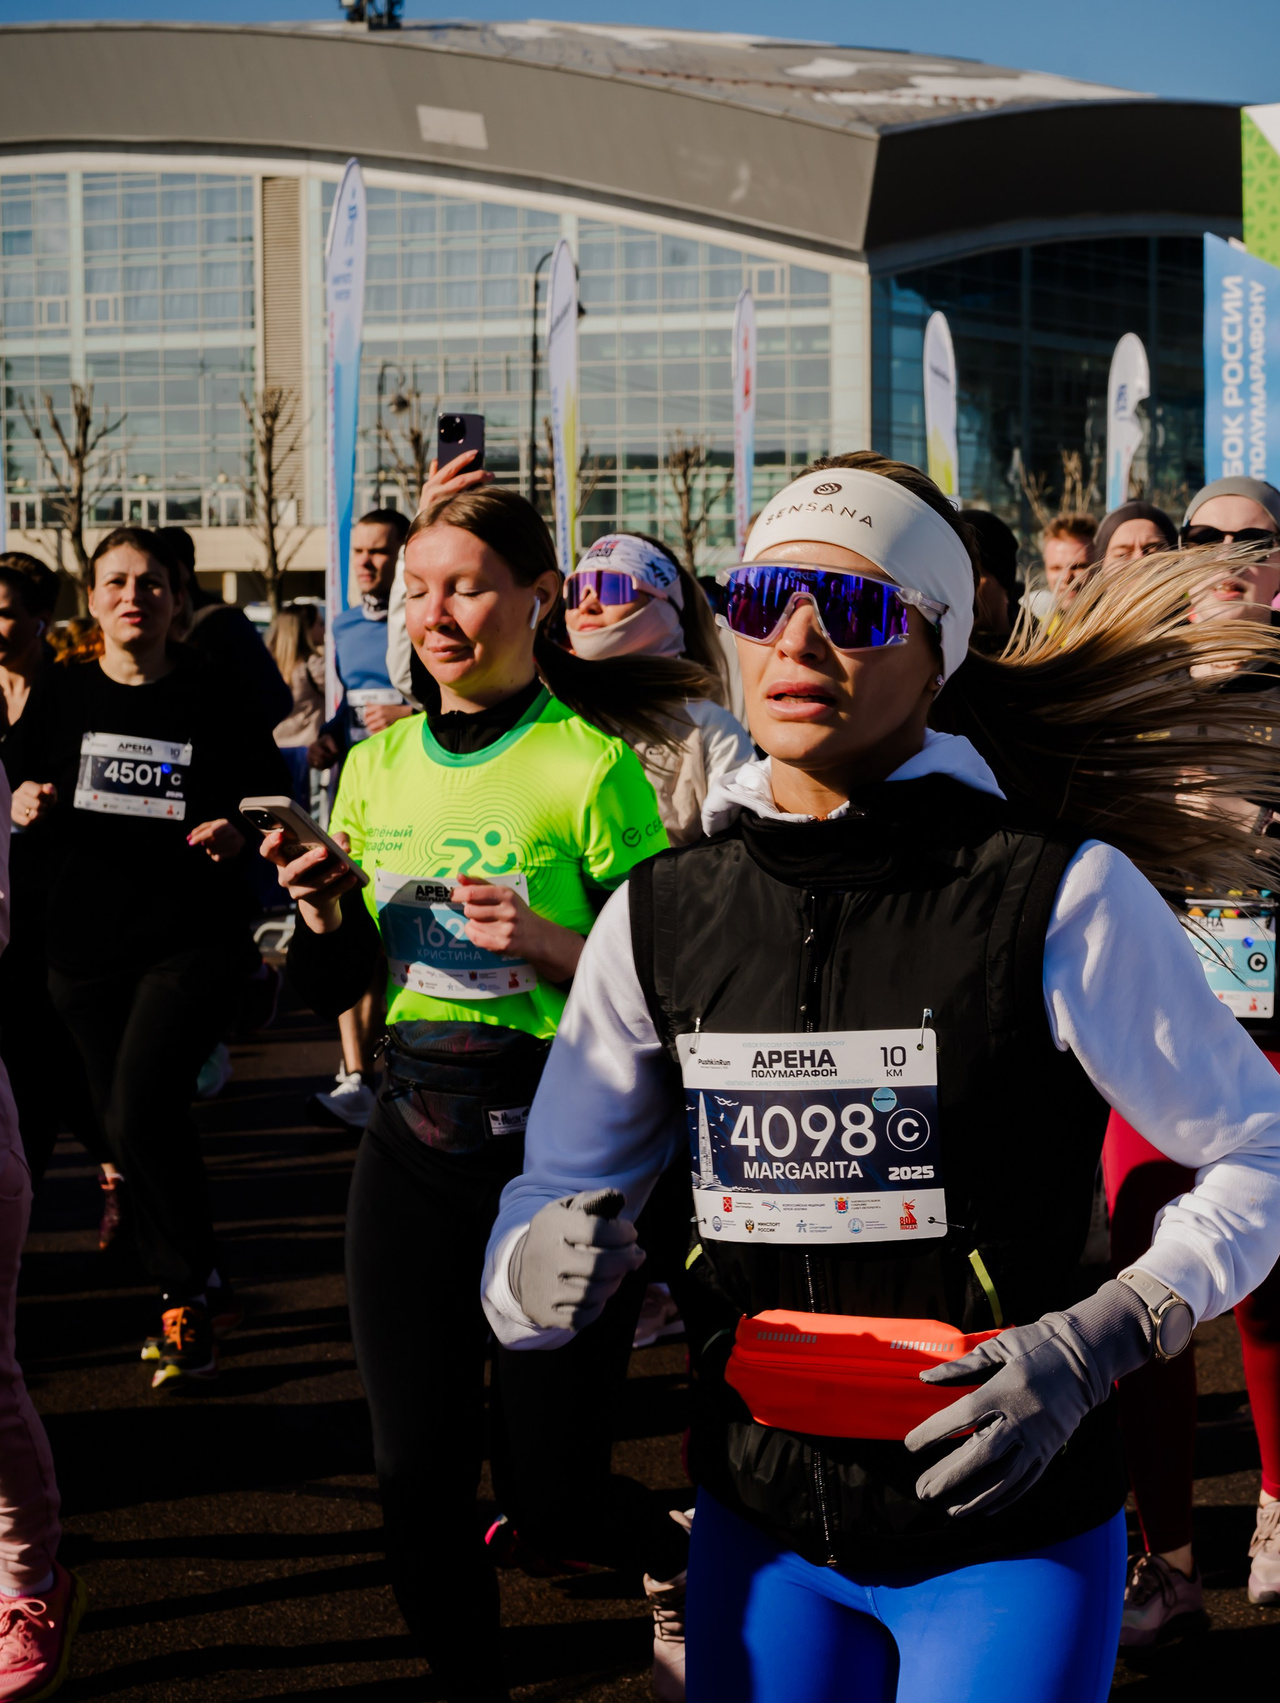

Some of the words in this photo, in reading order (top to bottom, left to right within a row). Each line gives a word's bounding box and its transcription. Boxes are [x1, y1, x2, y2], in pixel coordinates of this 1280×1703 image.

[1221, 274, 1246, 408] РОССИИ
[1247, 279, 1267, 481] ПОЛУМАРАФОНУ
[765, 501, 873, 529] SENSANA
[103, 760, 162, 787] 4501
[365, 824, 414, 839] елёный
[416, 948, 483, 961] КРИСТИНА
[697, 1058, 731, 1067] PushkinRun
[752, 1049, 836, 1069] АРЕНА
[880, 1046, 907, 1068] 10
[751, 1068, 838, 1079] ПОЛУМАРАФОН
[885, 1069, 903, 1077] КМ
[730, 1103, 877, 1158] 4098
[743, 1160, 864, 1180] MARGARITA
[888, 1165, 935, 1181] 2025
